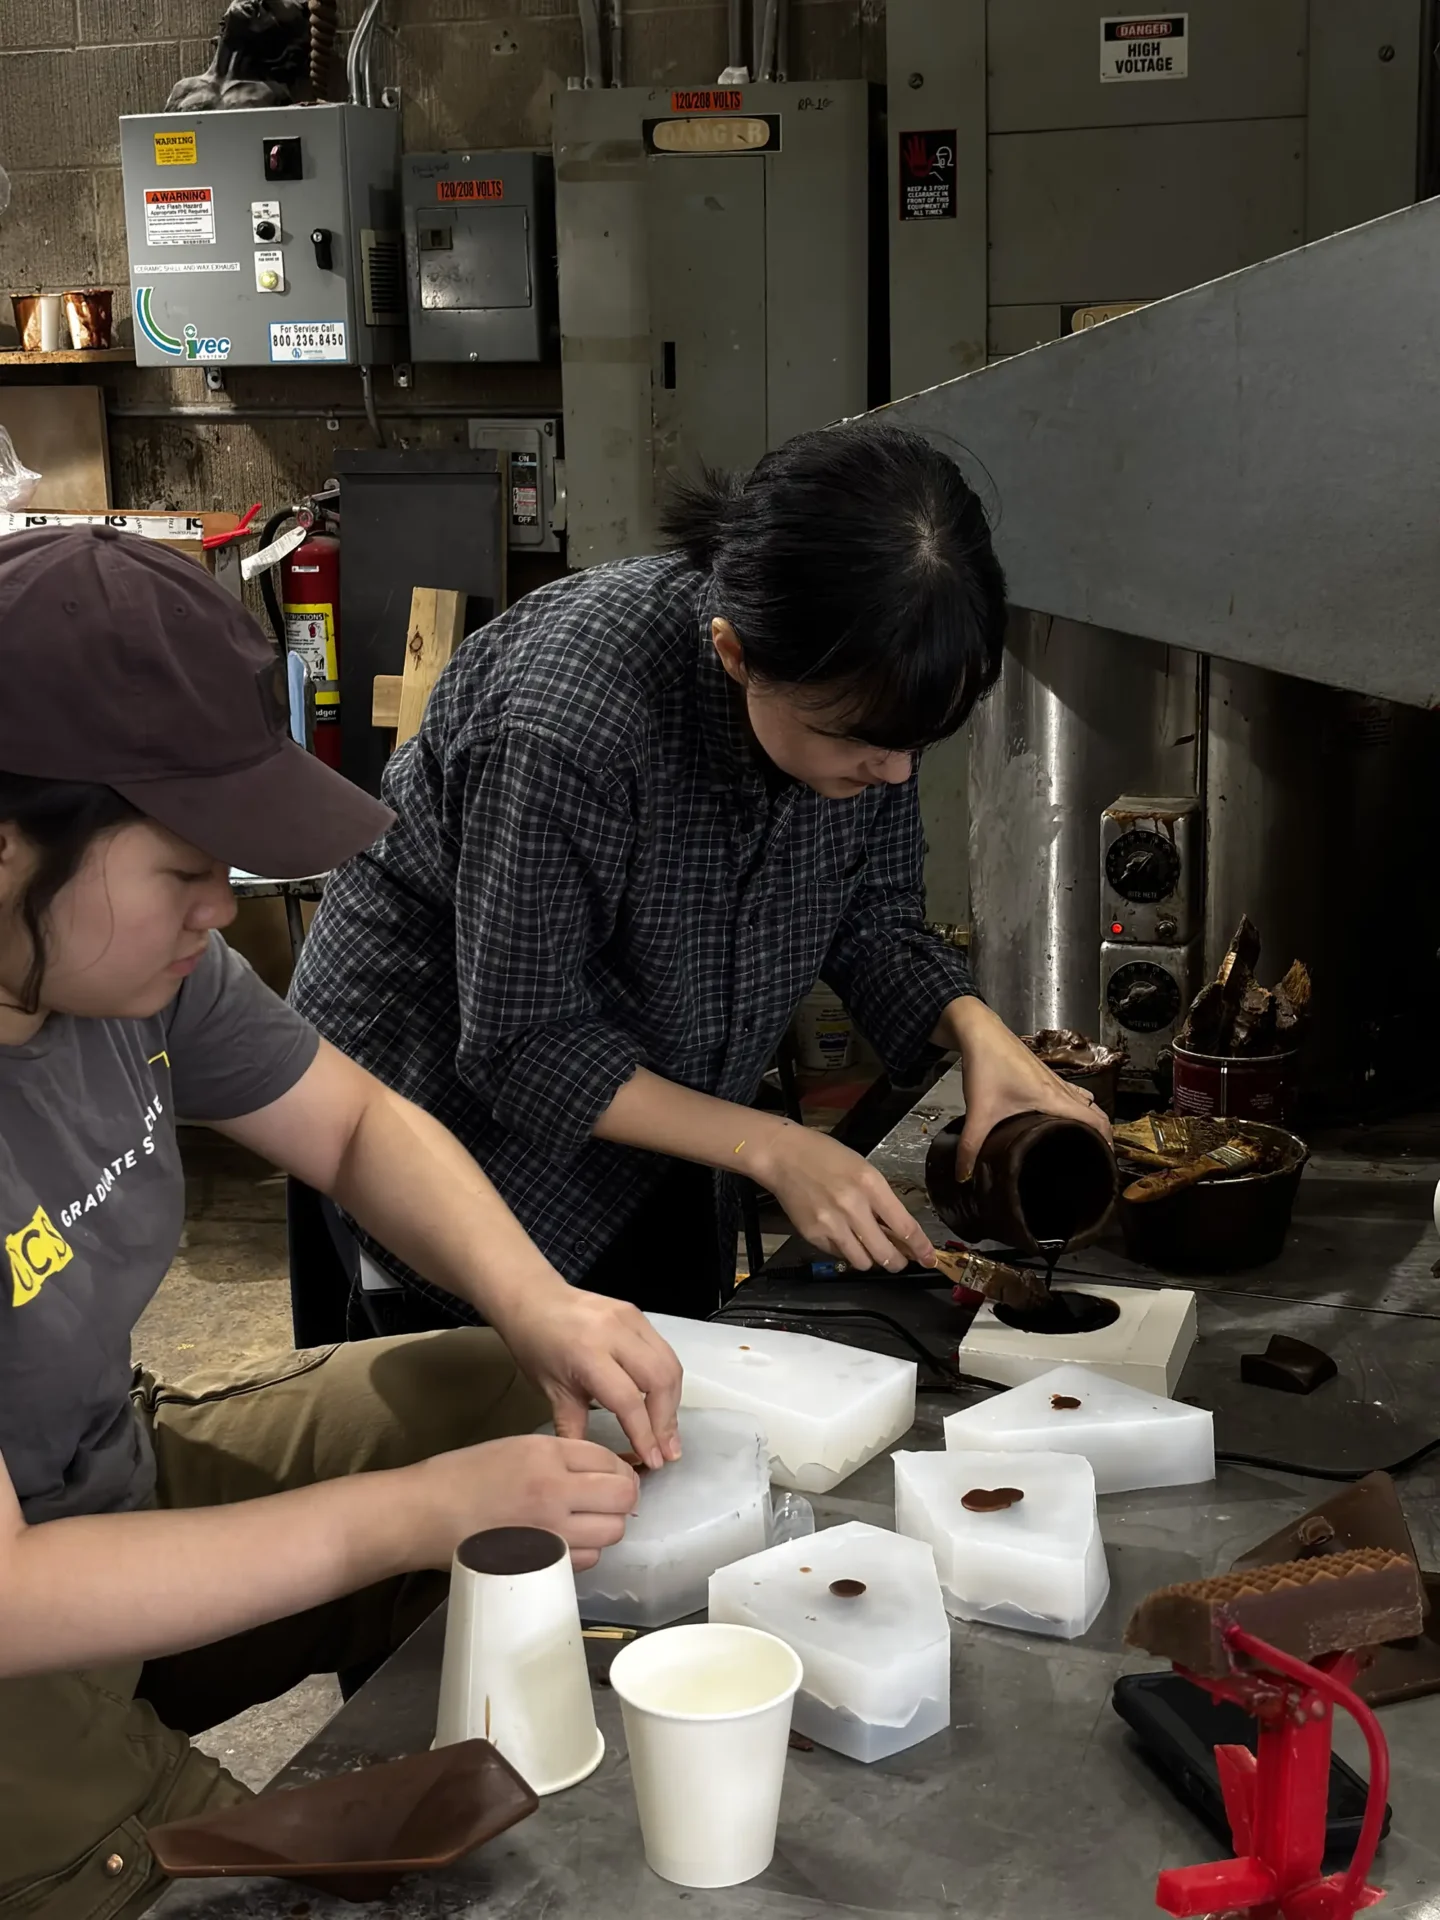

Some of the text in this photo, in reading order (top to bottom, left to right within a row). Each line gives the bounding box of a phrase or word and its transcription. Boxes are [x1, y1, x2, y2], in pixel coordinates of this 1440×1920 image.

[1120, 23, 1168, 36] DANGER
[1127, 42, 1160, 57] HIGH
[1115, 57, 1173, 74] VOLTAGE
[675, 91, 741, 109] 120/208 VOLTS
[662, 121, 763, 145] DANGER
[155, 136, 194, 146] WARNING
[161, 190, 206, 202] WARNING
[440, 180, 502, 198] 120/208 VOLTS
[280, 324, 335, 333] For Service Call
[273, 333, 343, 347] 800.236.8450
